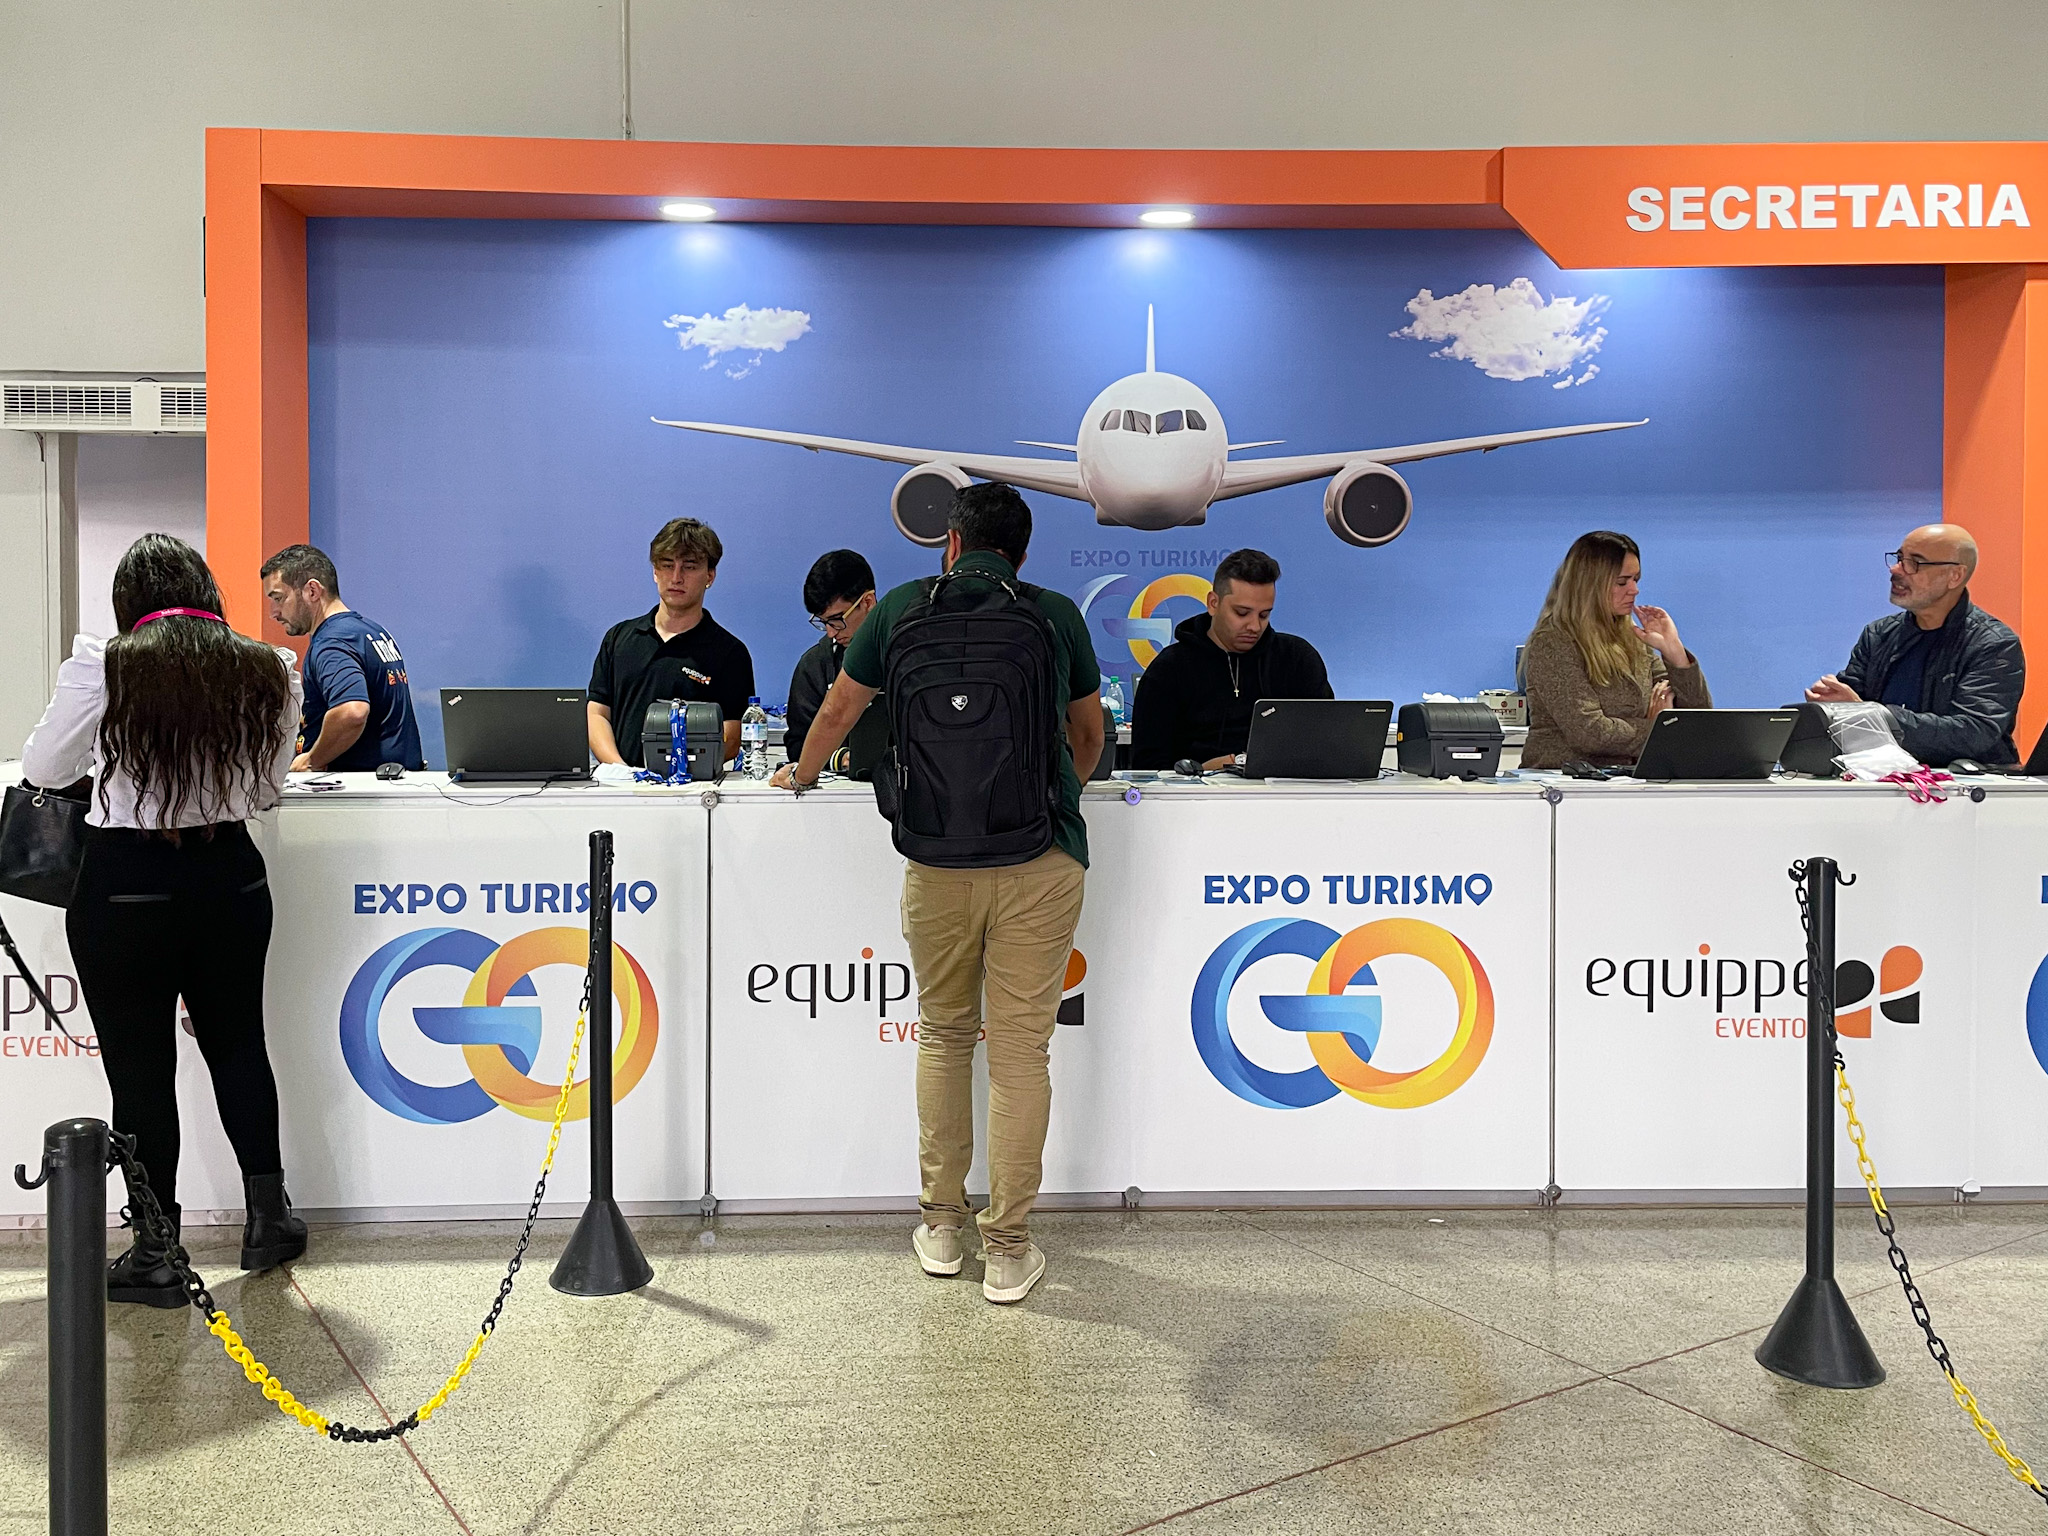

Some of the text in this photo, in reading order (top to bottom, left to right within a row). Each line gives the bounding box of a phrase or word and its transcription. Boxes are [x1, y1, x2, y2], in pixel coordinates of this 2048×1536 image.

[1626, 184, 2031, 232] SECRETARIA
[1070, 550, 1131, 567] EXPO
[354, 883, 467, 914] EXPO
[1203, 873, 1493, 906] EXPO TURISMO
[747, 947, 920, 1019] equip
[1190, 917, 1495, 1110] GO
[1715, 1018, 1807, 1039] EVENTO
[3, 1035, 101, 1057] EVENTO
